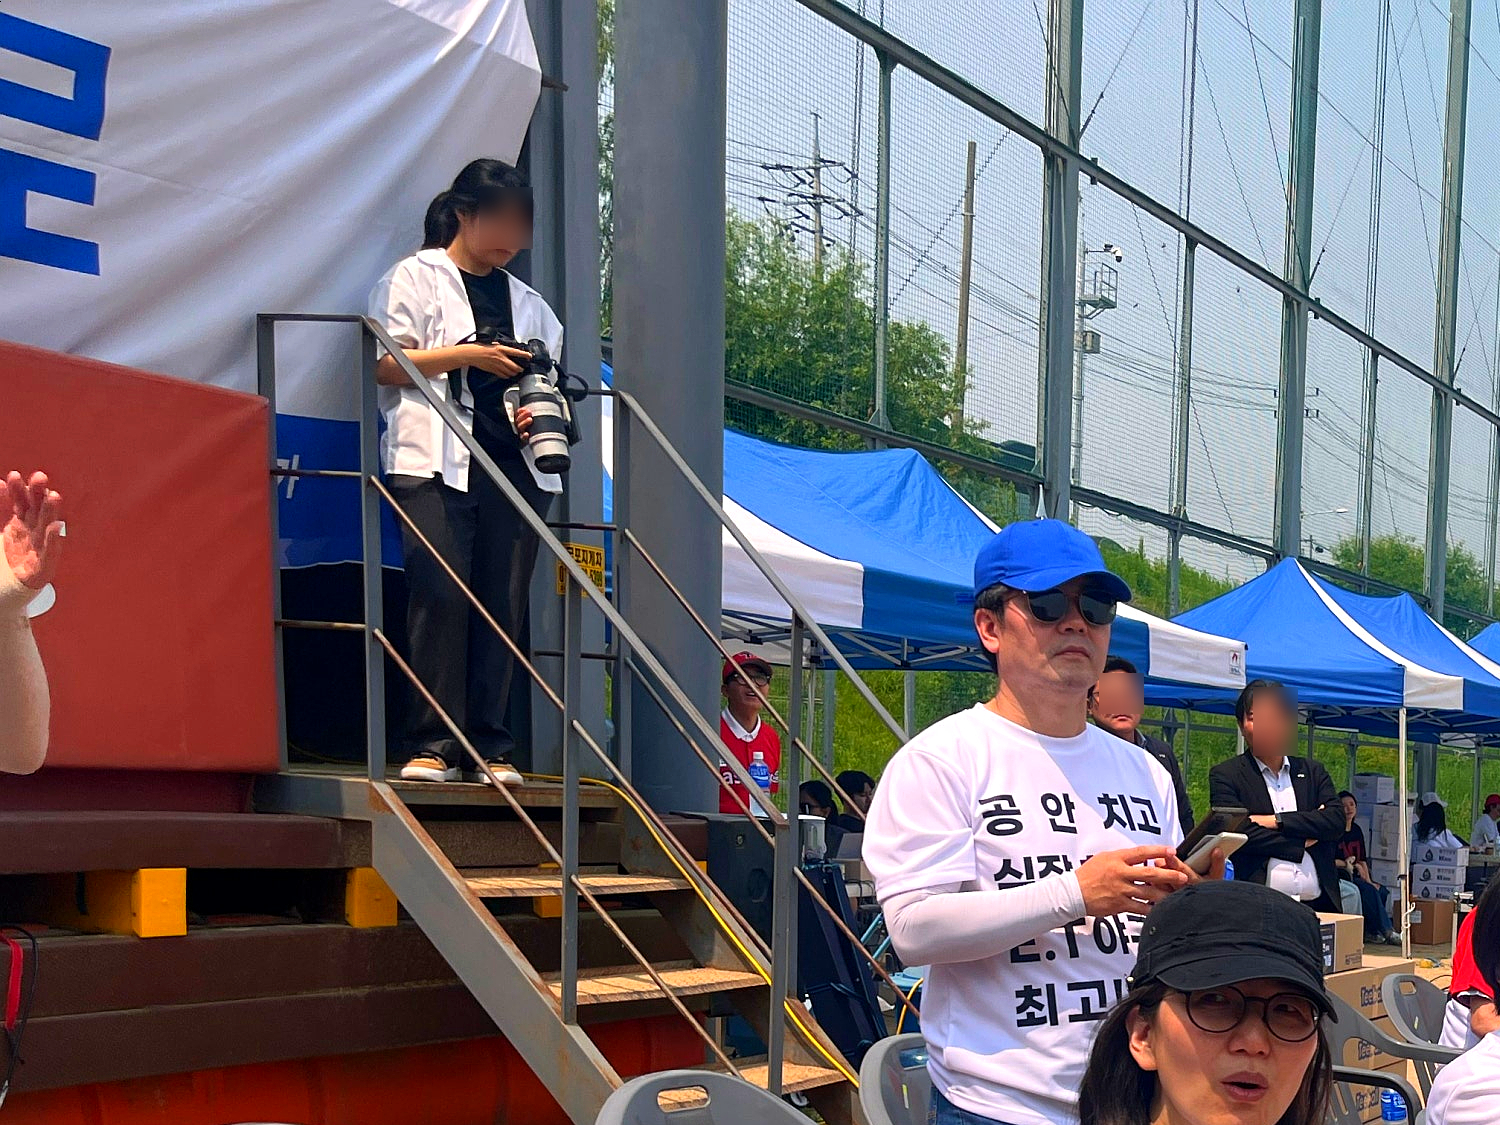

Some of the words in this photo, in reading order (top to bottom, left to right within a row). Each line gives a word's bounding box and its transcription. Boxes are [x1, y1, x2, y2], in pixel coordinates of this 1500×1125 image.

[979, 794, 1024, 836] 공
[1040, 792, 1078, 835] 안
[1097, 792, 1162, 836] 치고
